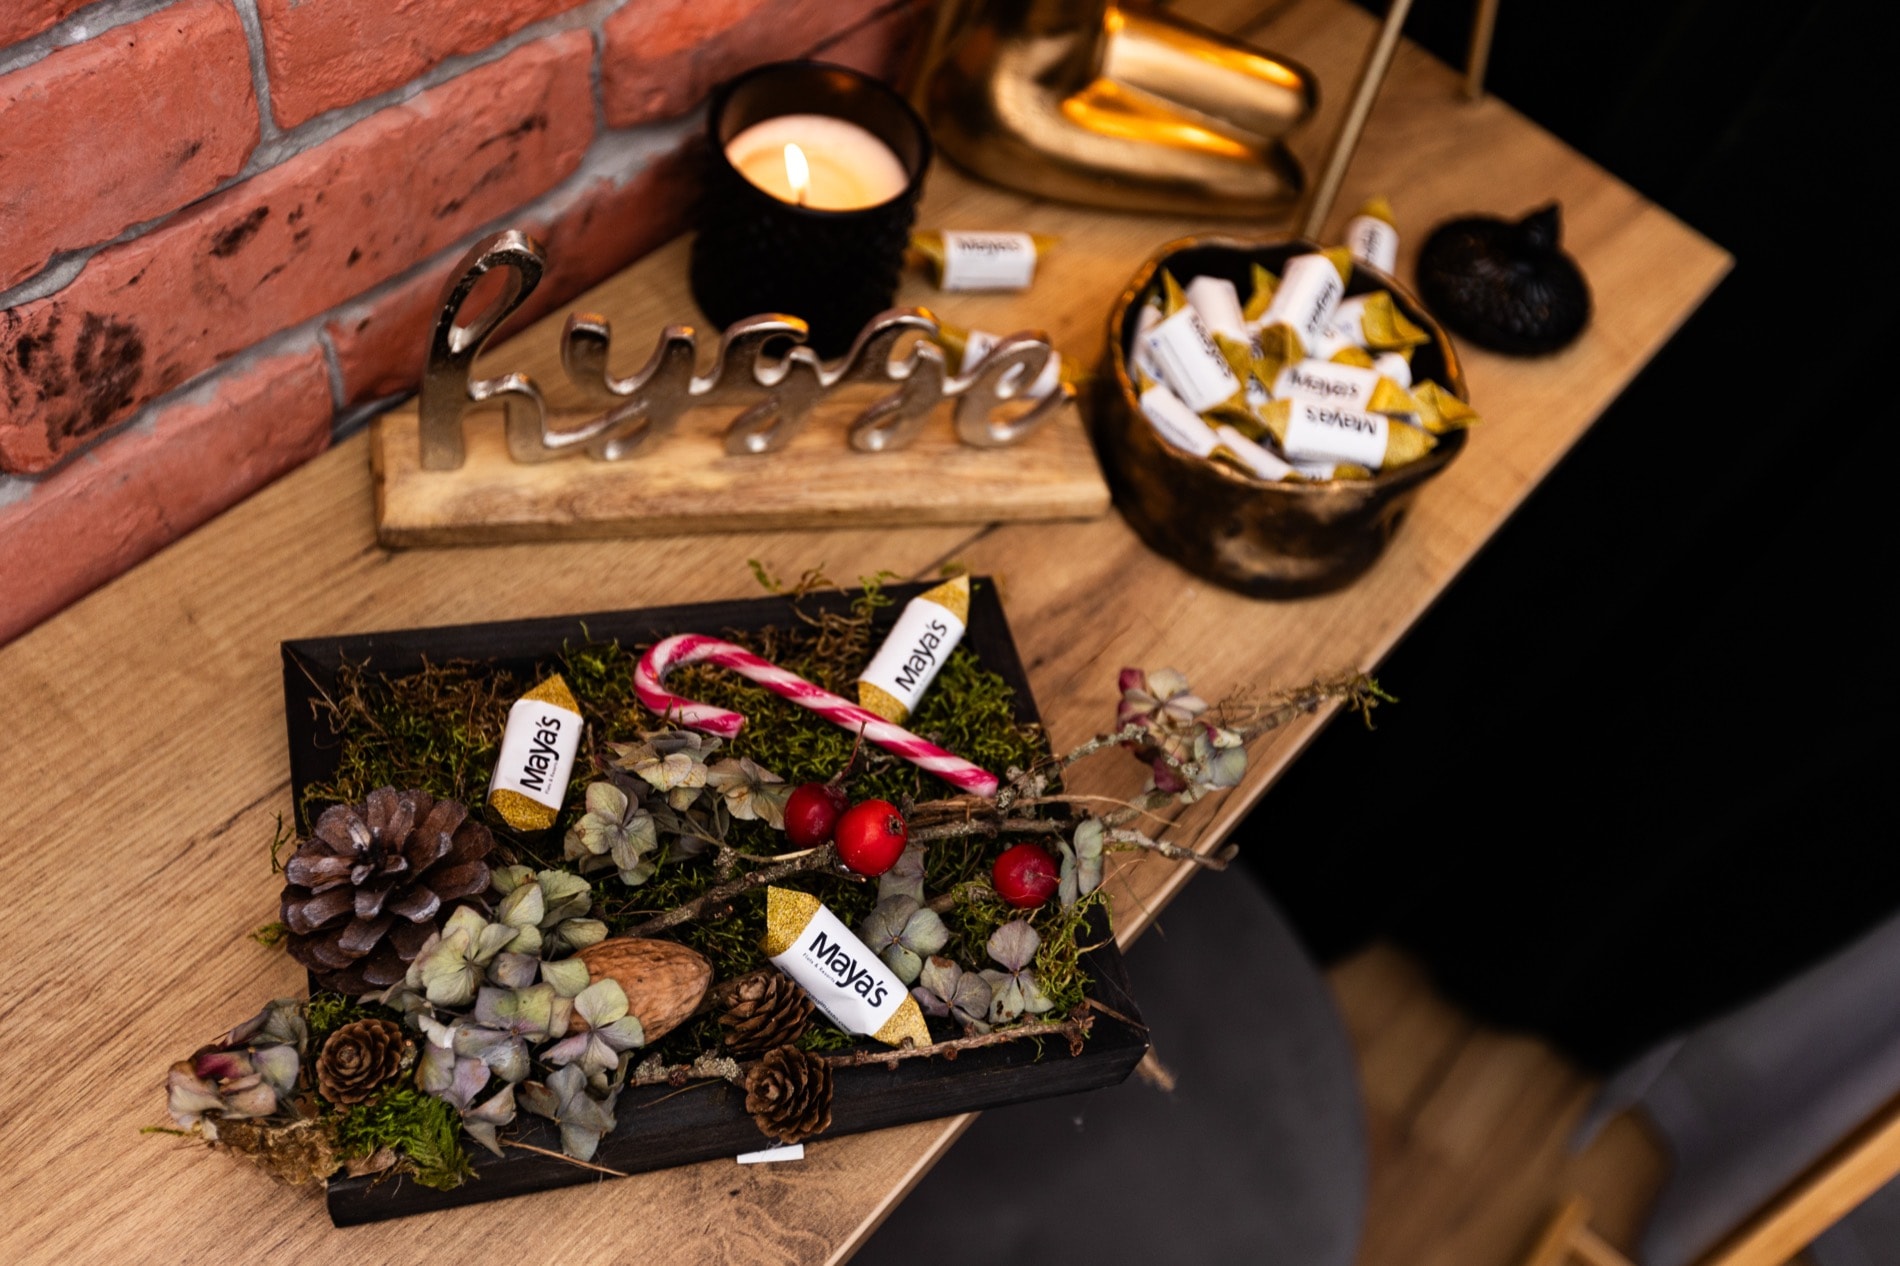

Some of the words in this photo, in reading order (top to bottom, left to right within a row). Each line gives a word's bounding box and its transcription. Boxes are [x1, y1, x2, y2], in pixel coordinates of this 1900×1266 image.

[419, 229, 1076, 472] hygge
[895, 619, 948, 692] Maya's
[519, 714, 562, 792] Maya's
[808, 930, 889, 1008] Maya's
